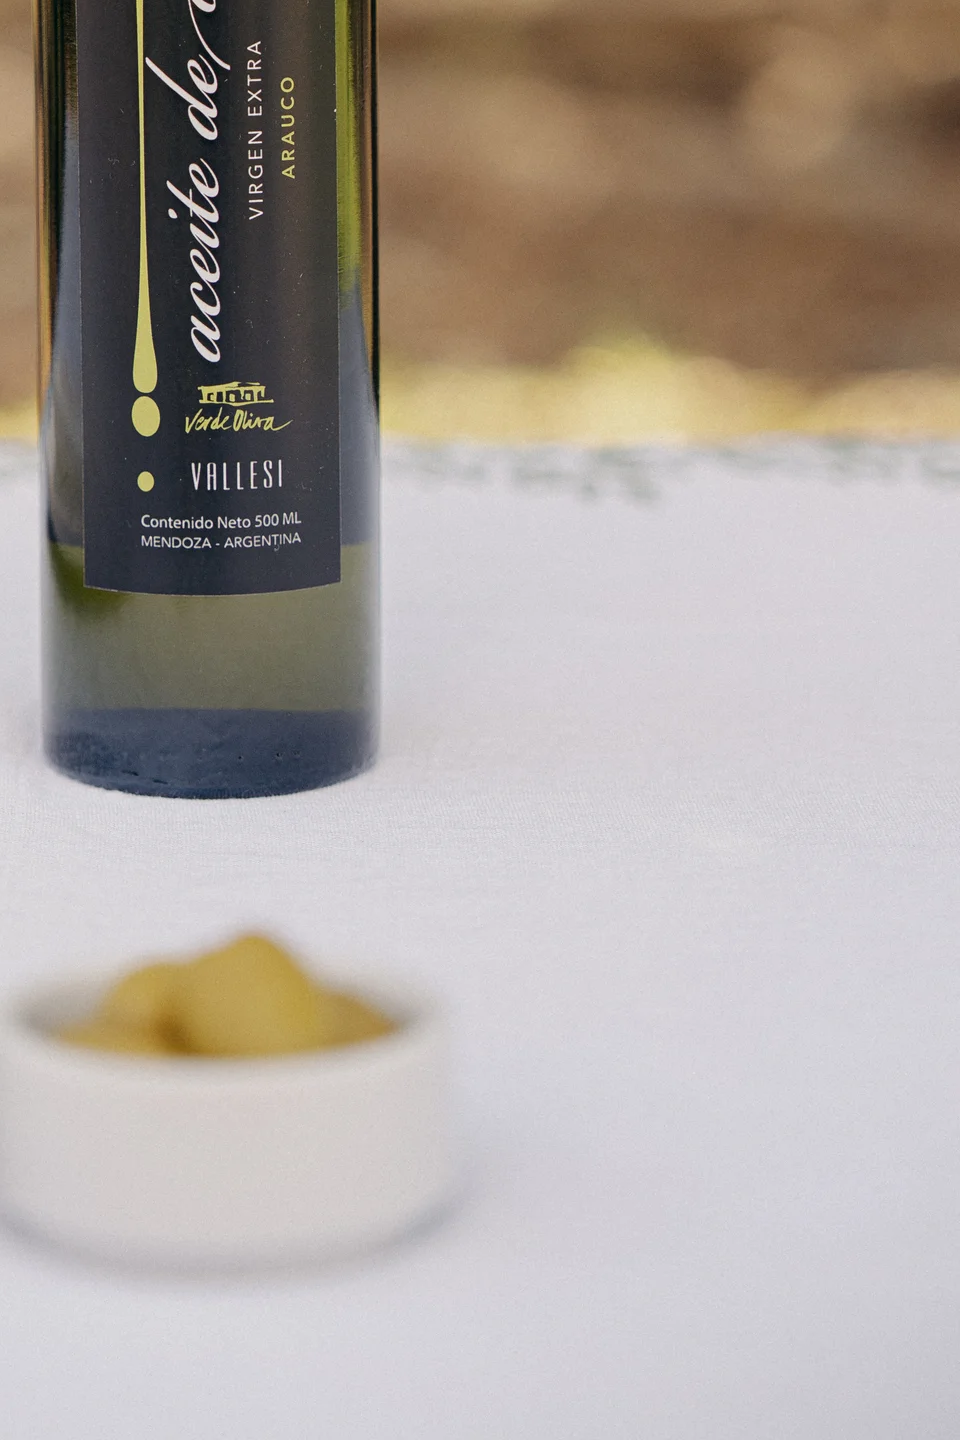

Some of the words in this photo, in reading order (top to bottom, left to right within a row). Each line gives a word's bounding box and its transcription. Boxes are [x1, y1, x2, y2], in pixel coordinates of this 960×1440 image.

[144, 54, 219, 141] de
[246, 40, 263, 117] EXTRA
[280, 76, 296, 180] ARAUCO
[247, 129, 264, 221] VIRGEN
[165, 157, 222, 363] aceite
[185, 407, 232, 434] Verde
[190, 459, 283, 491] VALLESI
[140, 513, 214, 530] Contenido
[216, 514, 252, 530] Neto
[254, 512, 280, 528] 500
[282, 511, 302, 526] ML
[140, 534, 212, 549] MENDOZA
[223, 531, 302, 549] ARGENTINA
